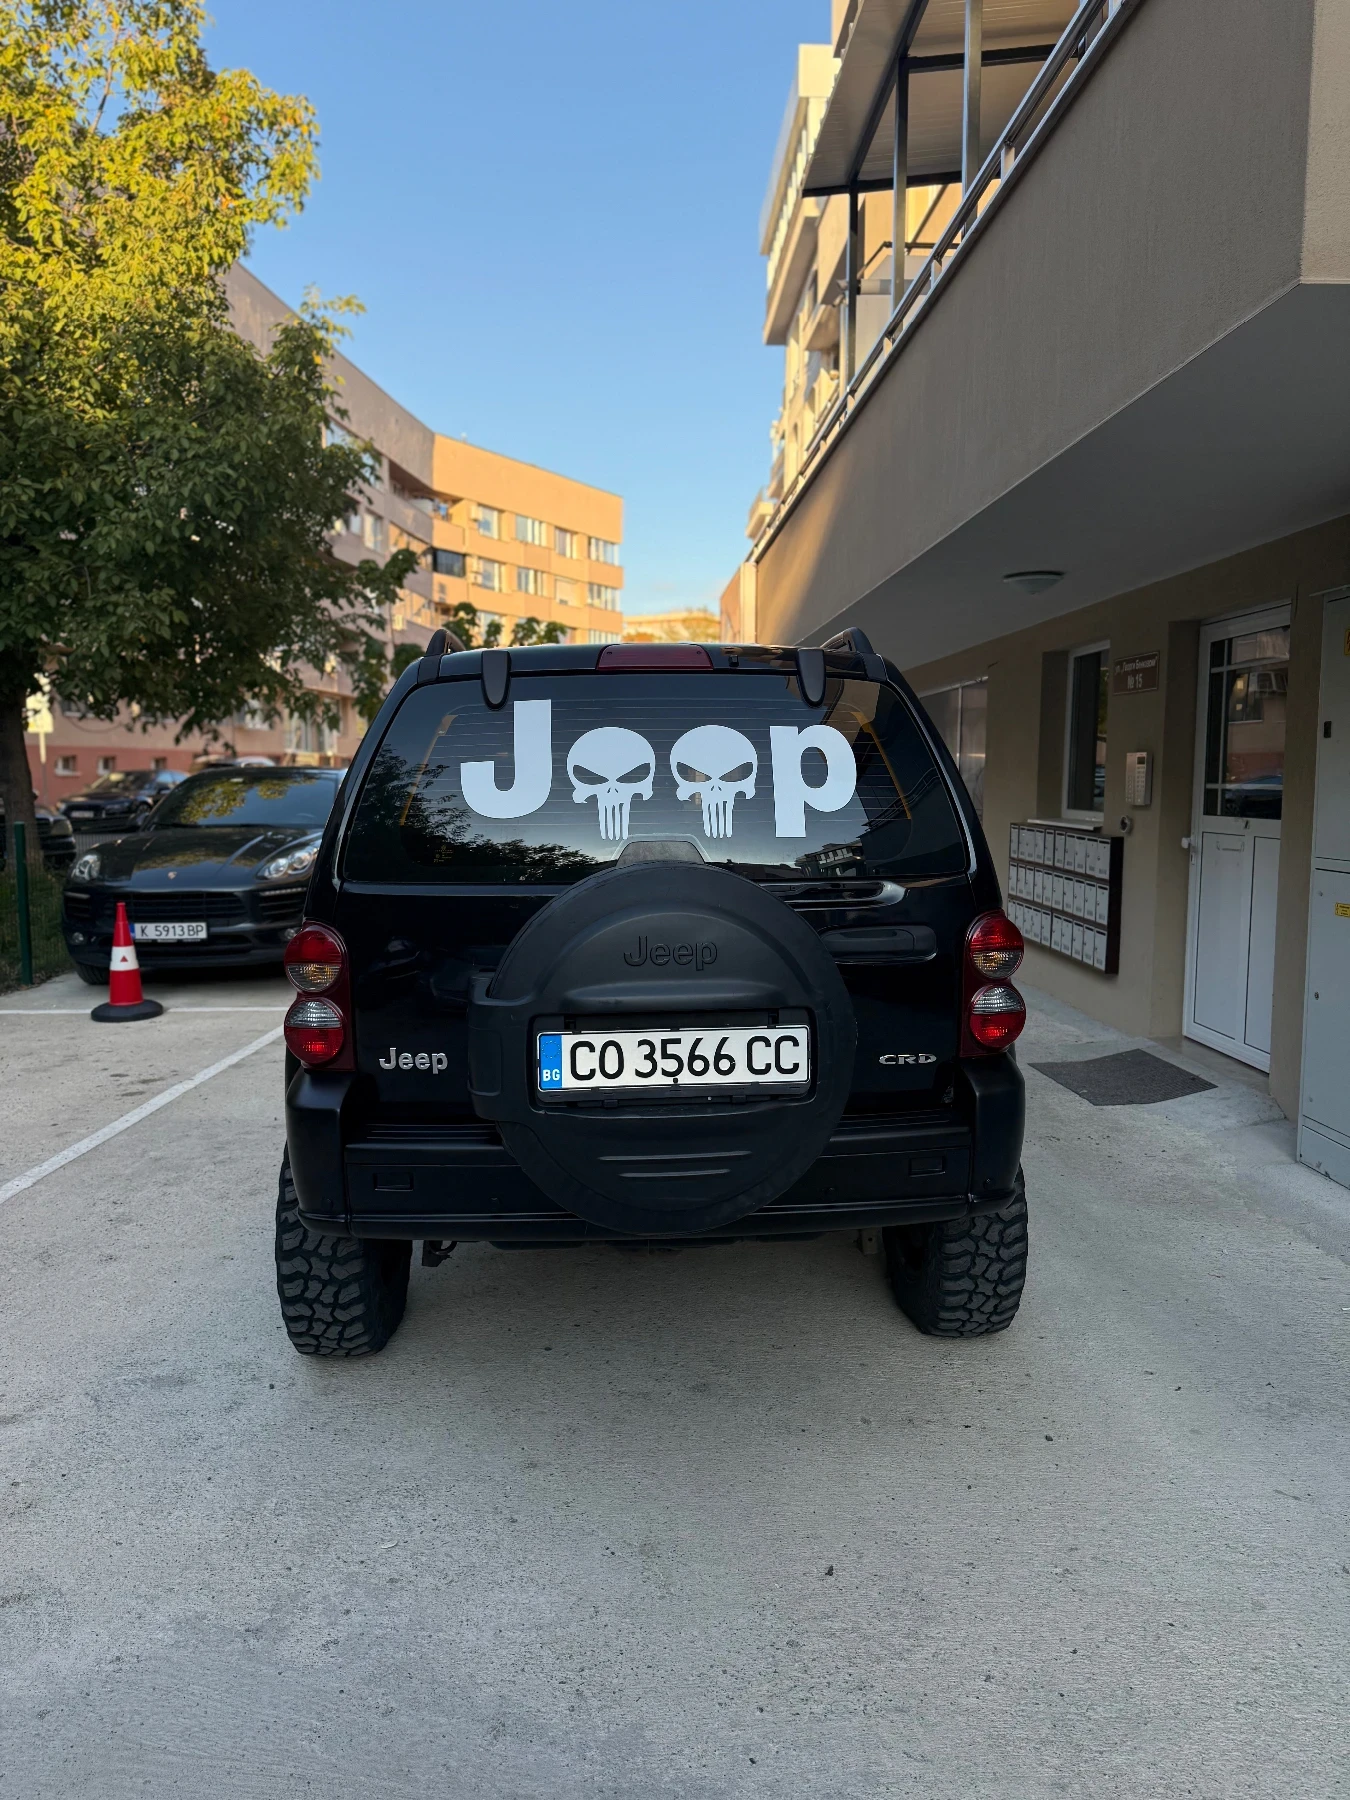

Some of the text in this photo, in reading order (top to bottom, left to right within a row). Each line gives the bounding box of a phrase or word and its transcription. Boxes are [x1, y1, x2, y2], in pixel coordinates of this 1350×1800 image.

[1136, 673, 1143, 689] 15
[140, 924, 204, 937] K 5913 BP
[623, 935, 718, 972] Jeep
[378, 1047, 449, 1075] Jeep
[634, 1036, 737, 1079] 3566
[746, 1035, 800, 1076] CC
[878, 1053, 937, 1065] CRD
[542, 1069, 561, 1082] BG
